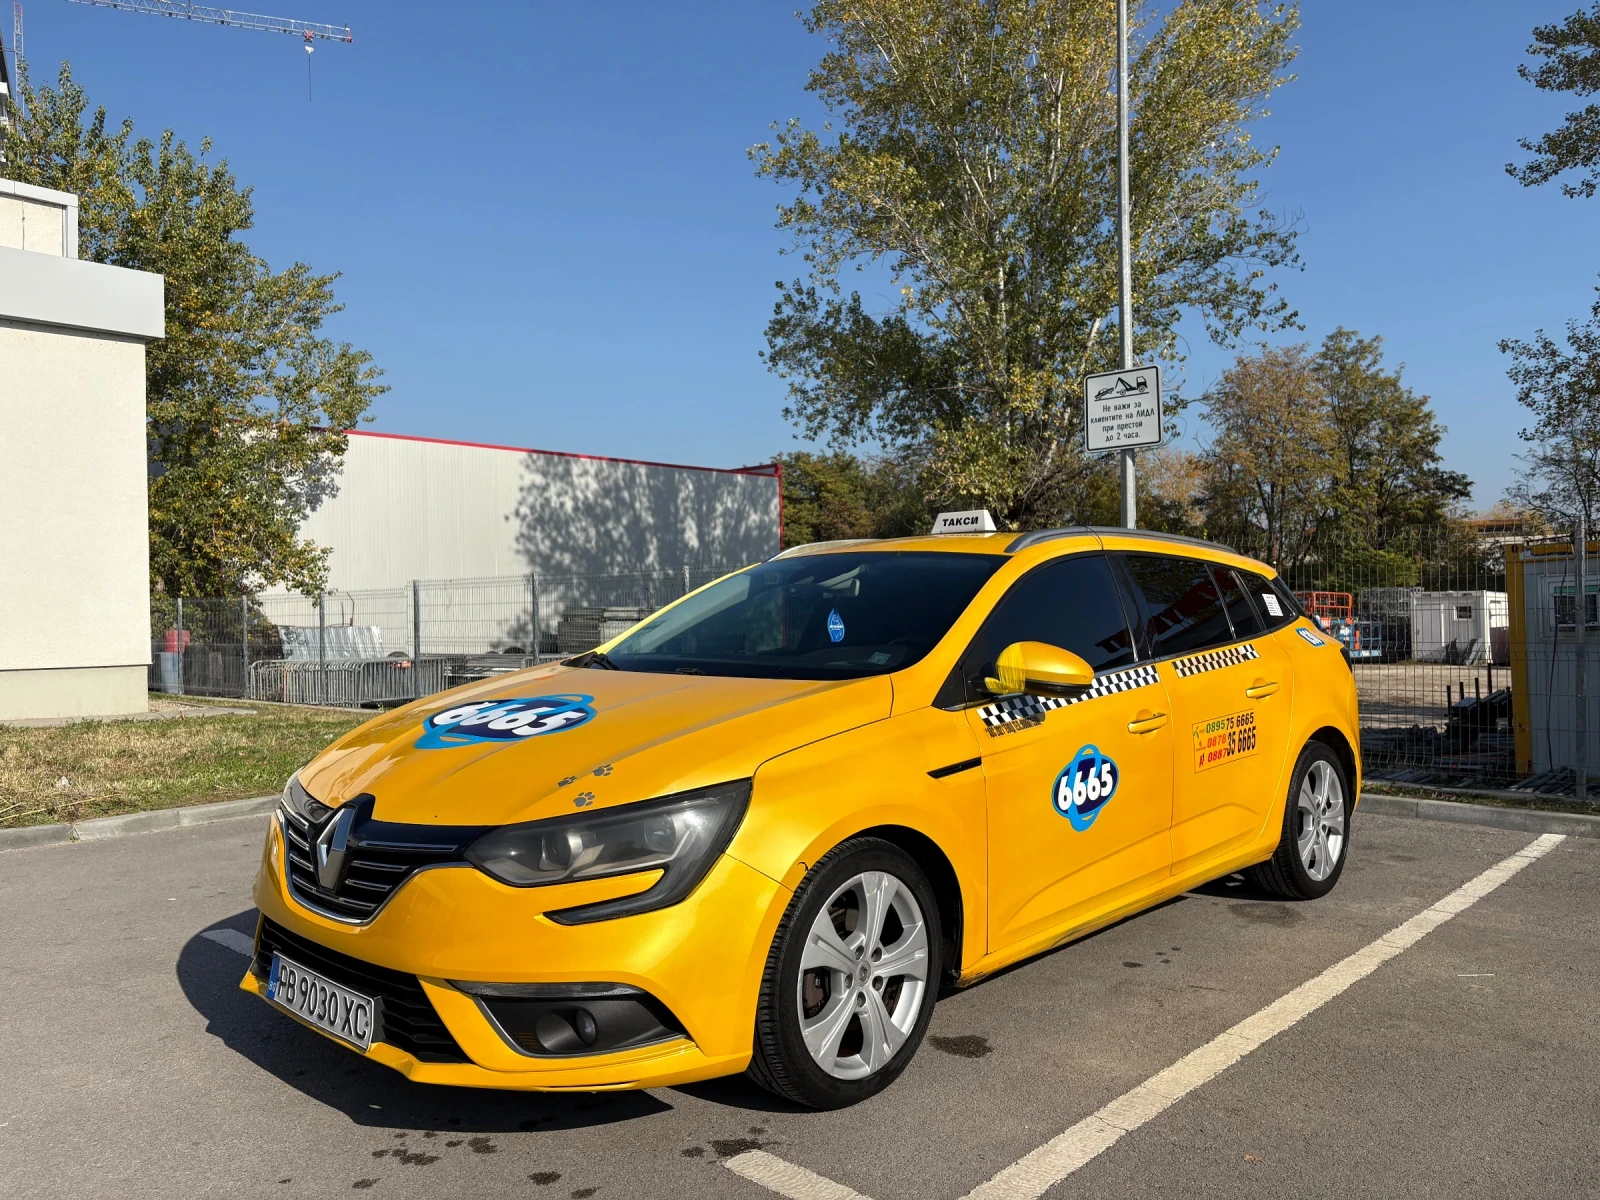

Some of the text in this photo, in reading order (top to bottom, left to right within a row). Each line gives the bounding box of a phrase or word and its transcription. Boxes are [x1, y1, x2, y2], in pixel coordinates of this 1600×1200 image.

[1102, 404, 1111, 412] Не
[1113, 403, 1131, 411] важи
[1090, 414, 1123, 424] клиентите
[1136, 408, 1155, 417] ЛИДЛ
[1102, 421, 1143, 434] при престой
[1116, 432, 1121, 440] 2
[942, 516, 979, 527] ТАКСИ
[433, 701, 587, 736] 6665
[1236, 712, 1254, 728] 6665
[1207, 726, 1256, 756] 0878 35 6665
[1057, 762, 1113, 811] 6665
[300, 976, 339, 1026] 9030
